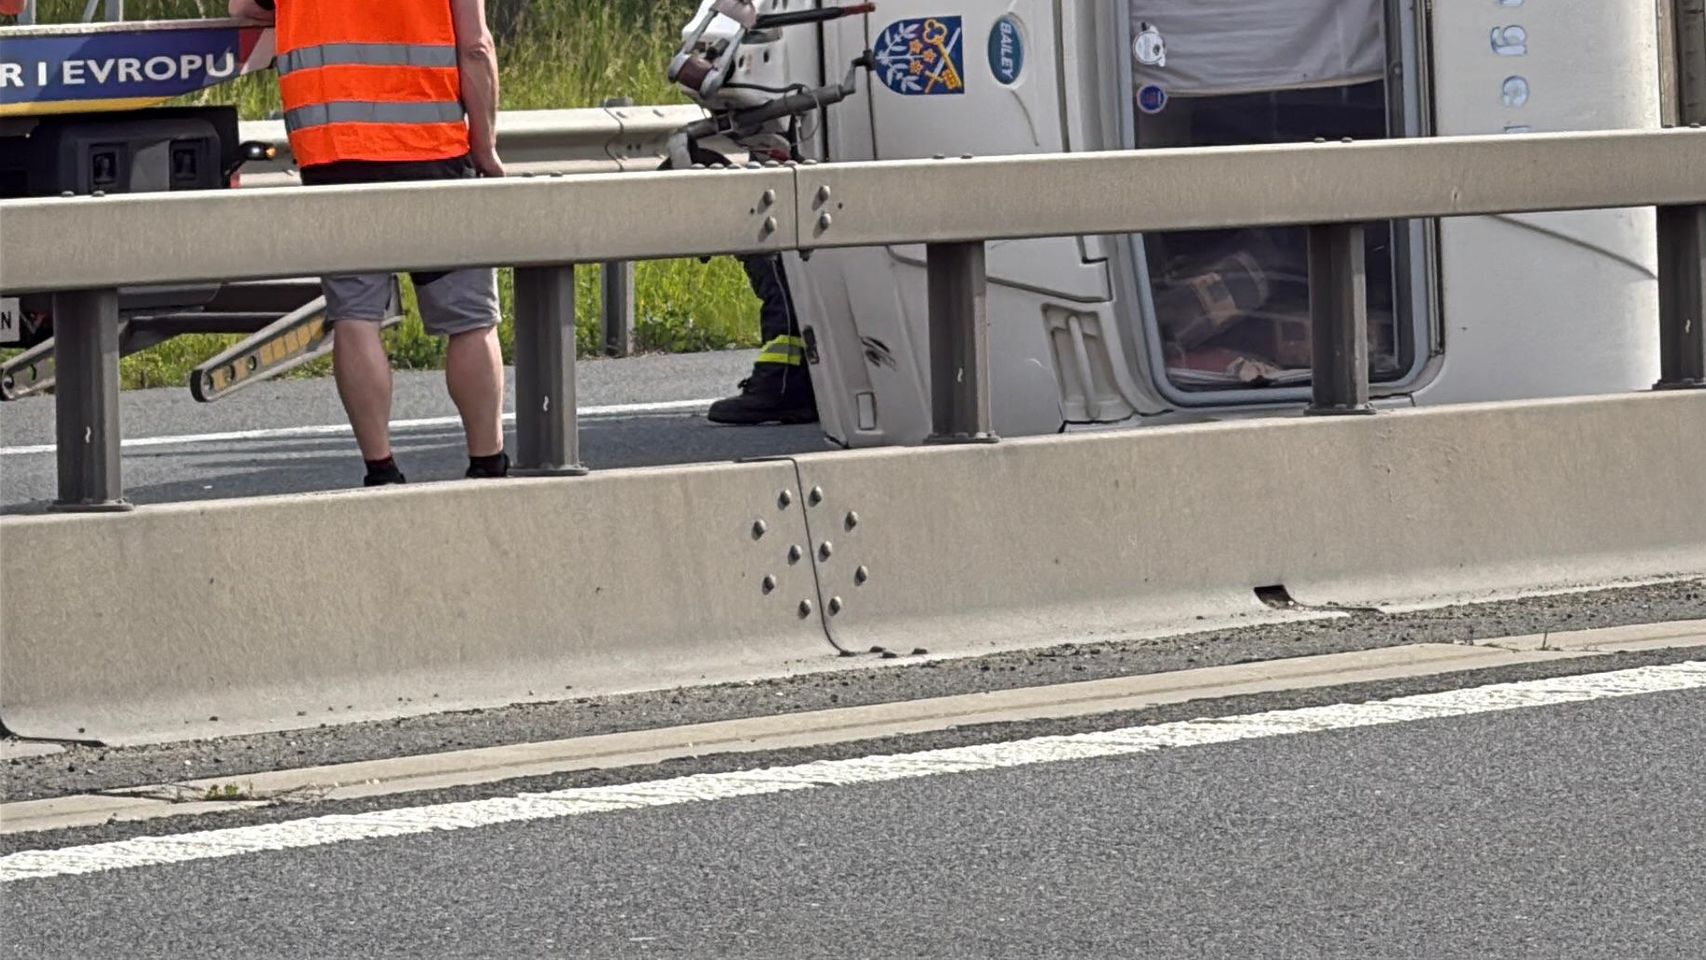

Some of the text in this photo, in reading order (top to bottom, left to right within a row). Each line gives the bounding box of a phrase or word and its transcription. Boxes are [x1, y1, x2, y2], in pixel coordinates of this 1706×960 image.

[37, 61, 47, 87] I
[62, 52, 235, 86] EVROPU
[1000, 21, 1014, 79] BAILEY
